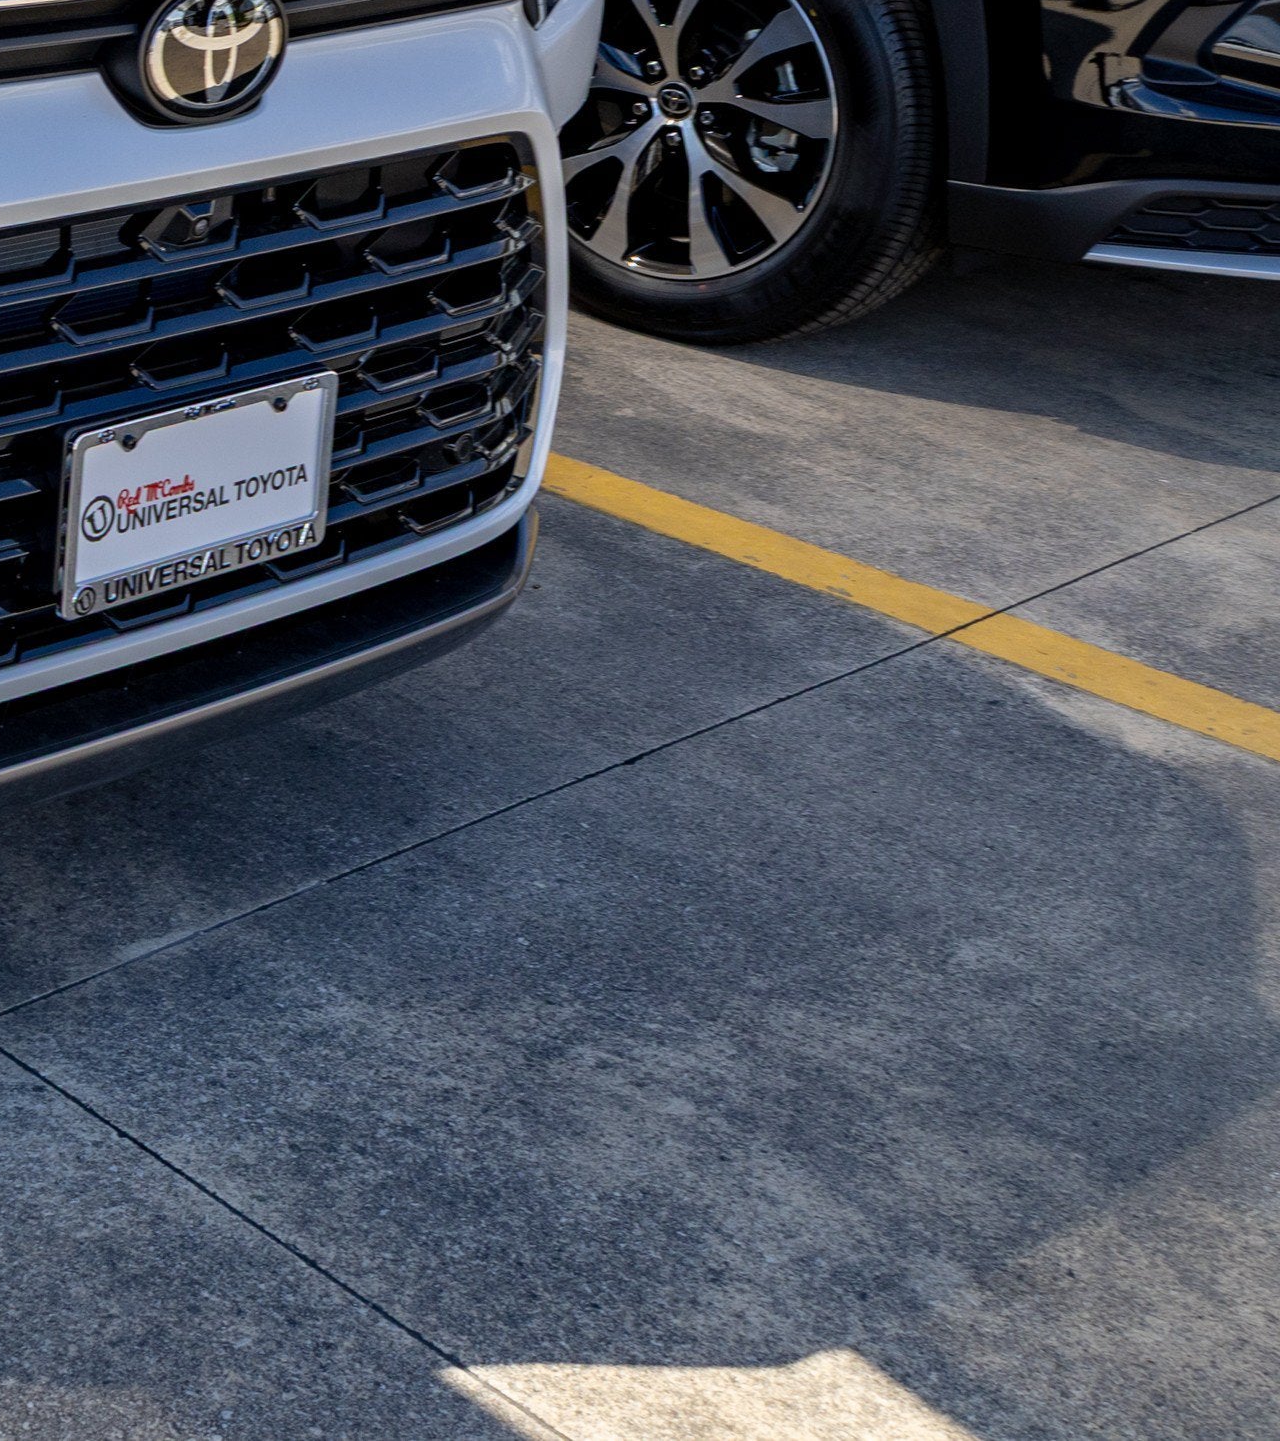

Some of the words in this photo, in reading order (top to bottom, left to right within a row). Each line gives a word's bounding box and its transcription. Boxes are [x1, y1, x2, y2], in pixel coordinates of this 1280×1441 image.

[117, 486, 229, 533] UNIVERSAL
[234, 464, 308, 501] TOYOTA
[117, 486, 141, 512] Red
[103, 548, 231, 604] UNIVERSAL
[234, 523, 317, 564] TOYOTA
